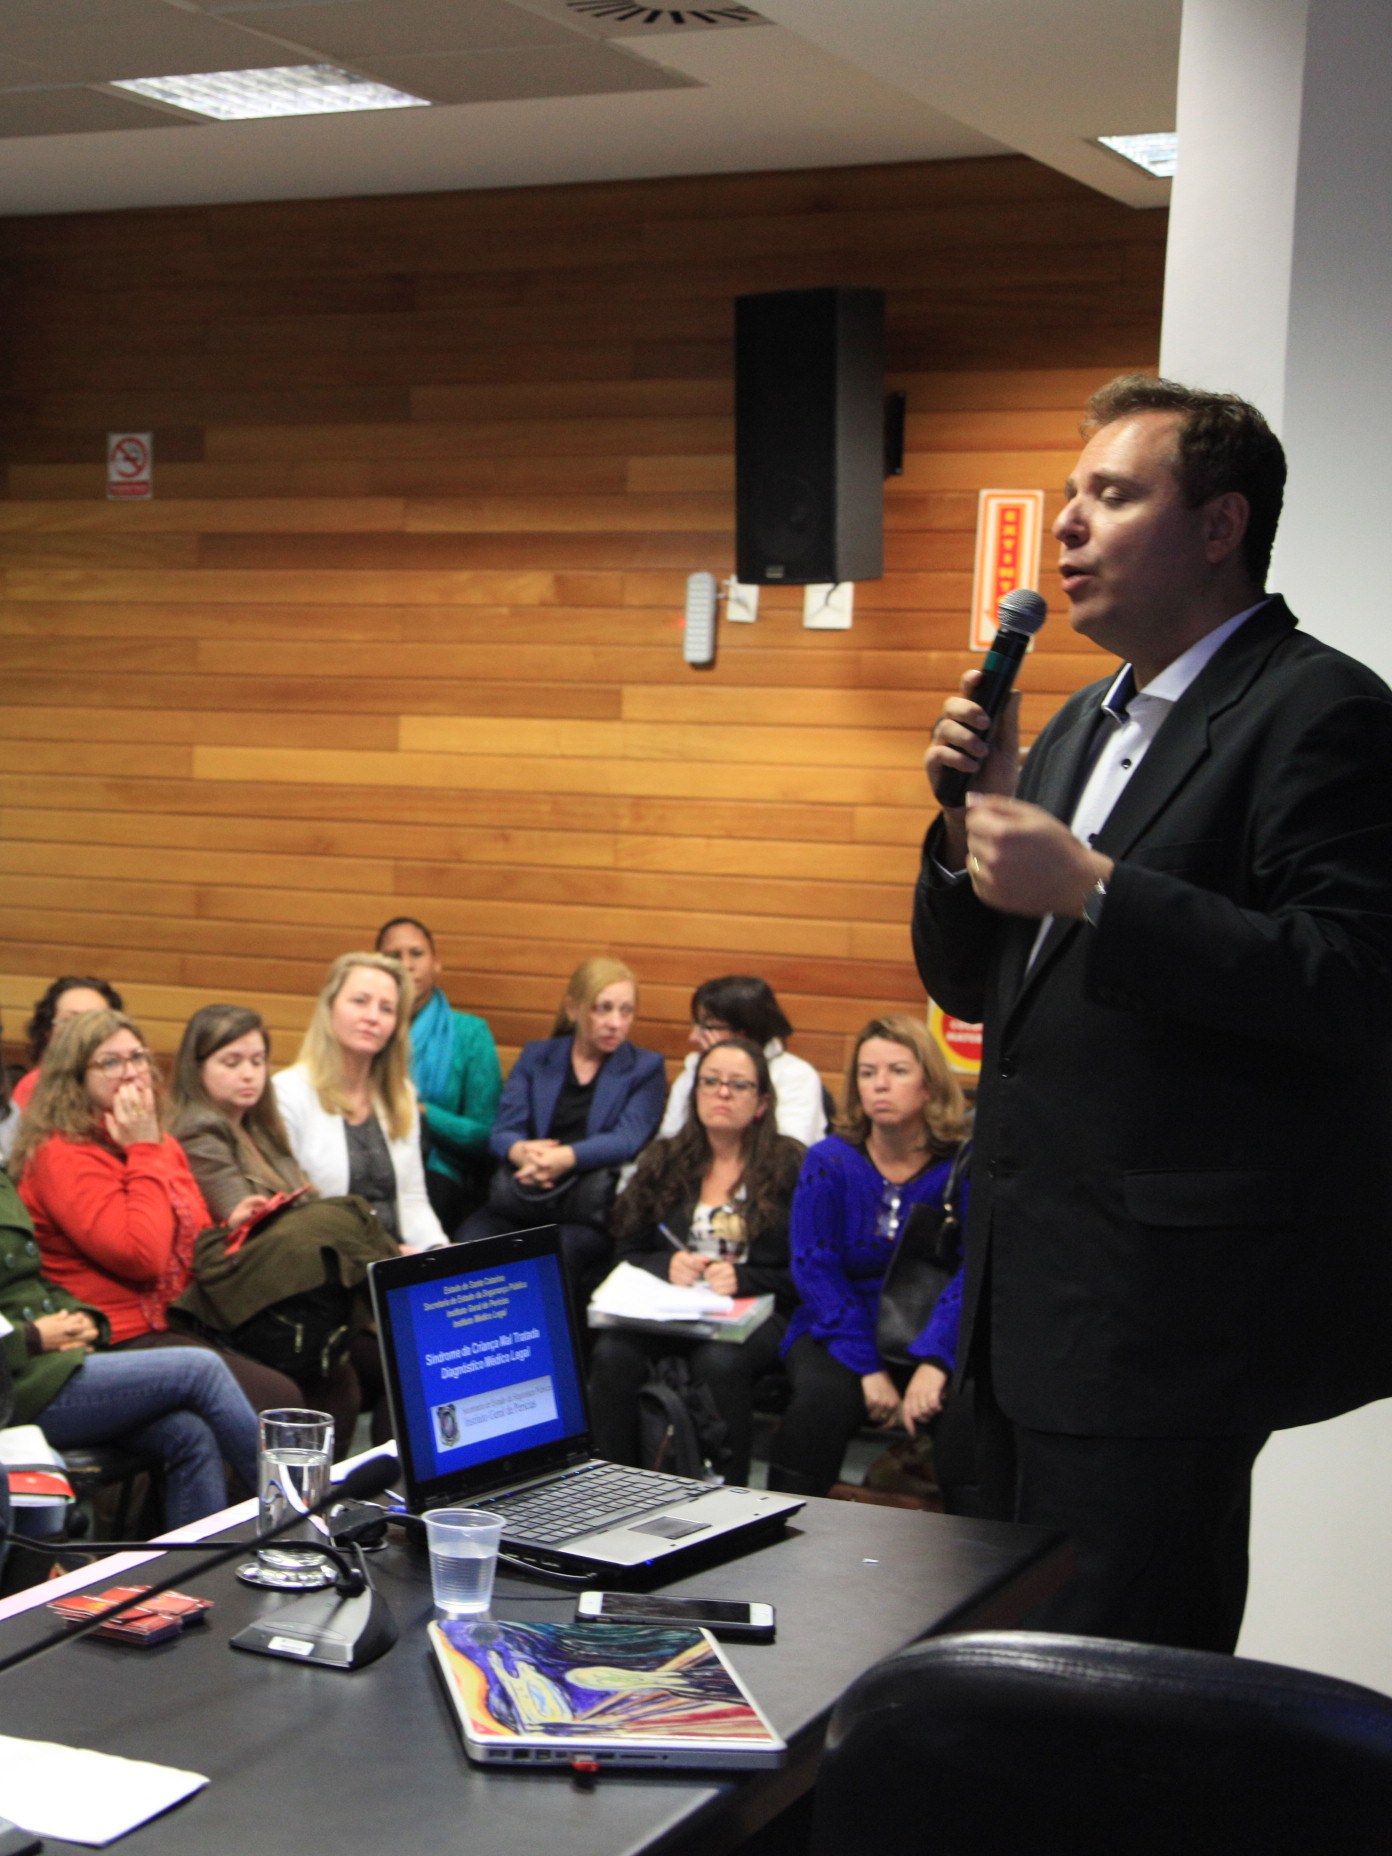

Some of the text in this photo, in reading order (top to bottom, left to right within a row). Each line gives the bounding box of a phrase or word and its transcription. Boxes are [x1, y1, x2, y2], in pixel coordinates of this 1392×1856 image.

[499, 1334, 513, 1347] Mal
[513, 1328, 540, 1342] Tratada
[510, 1346, 530, 1361] Legal
